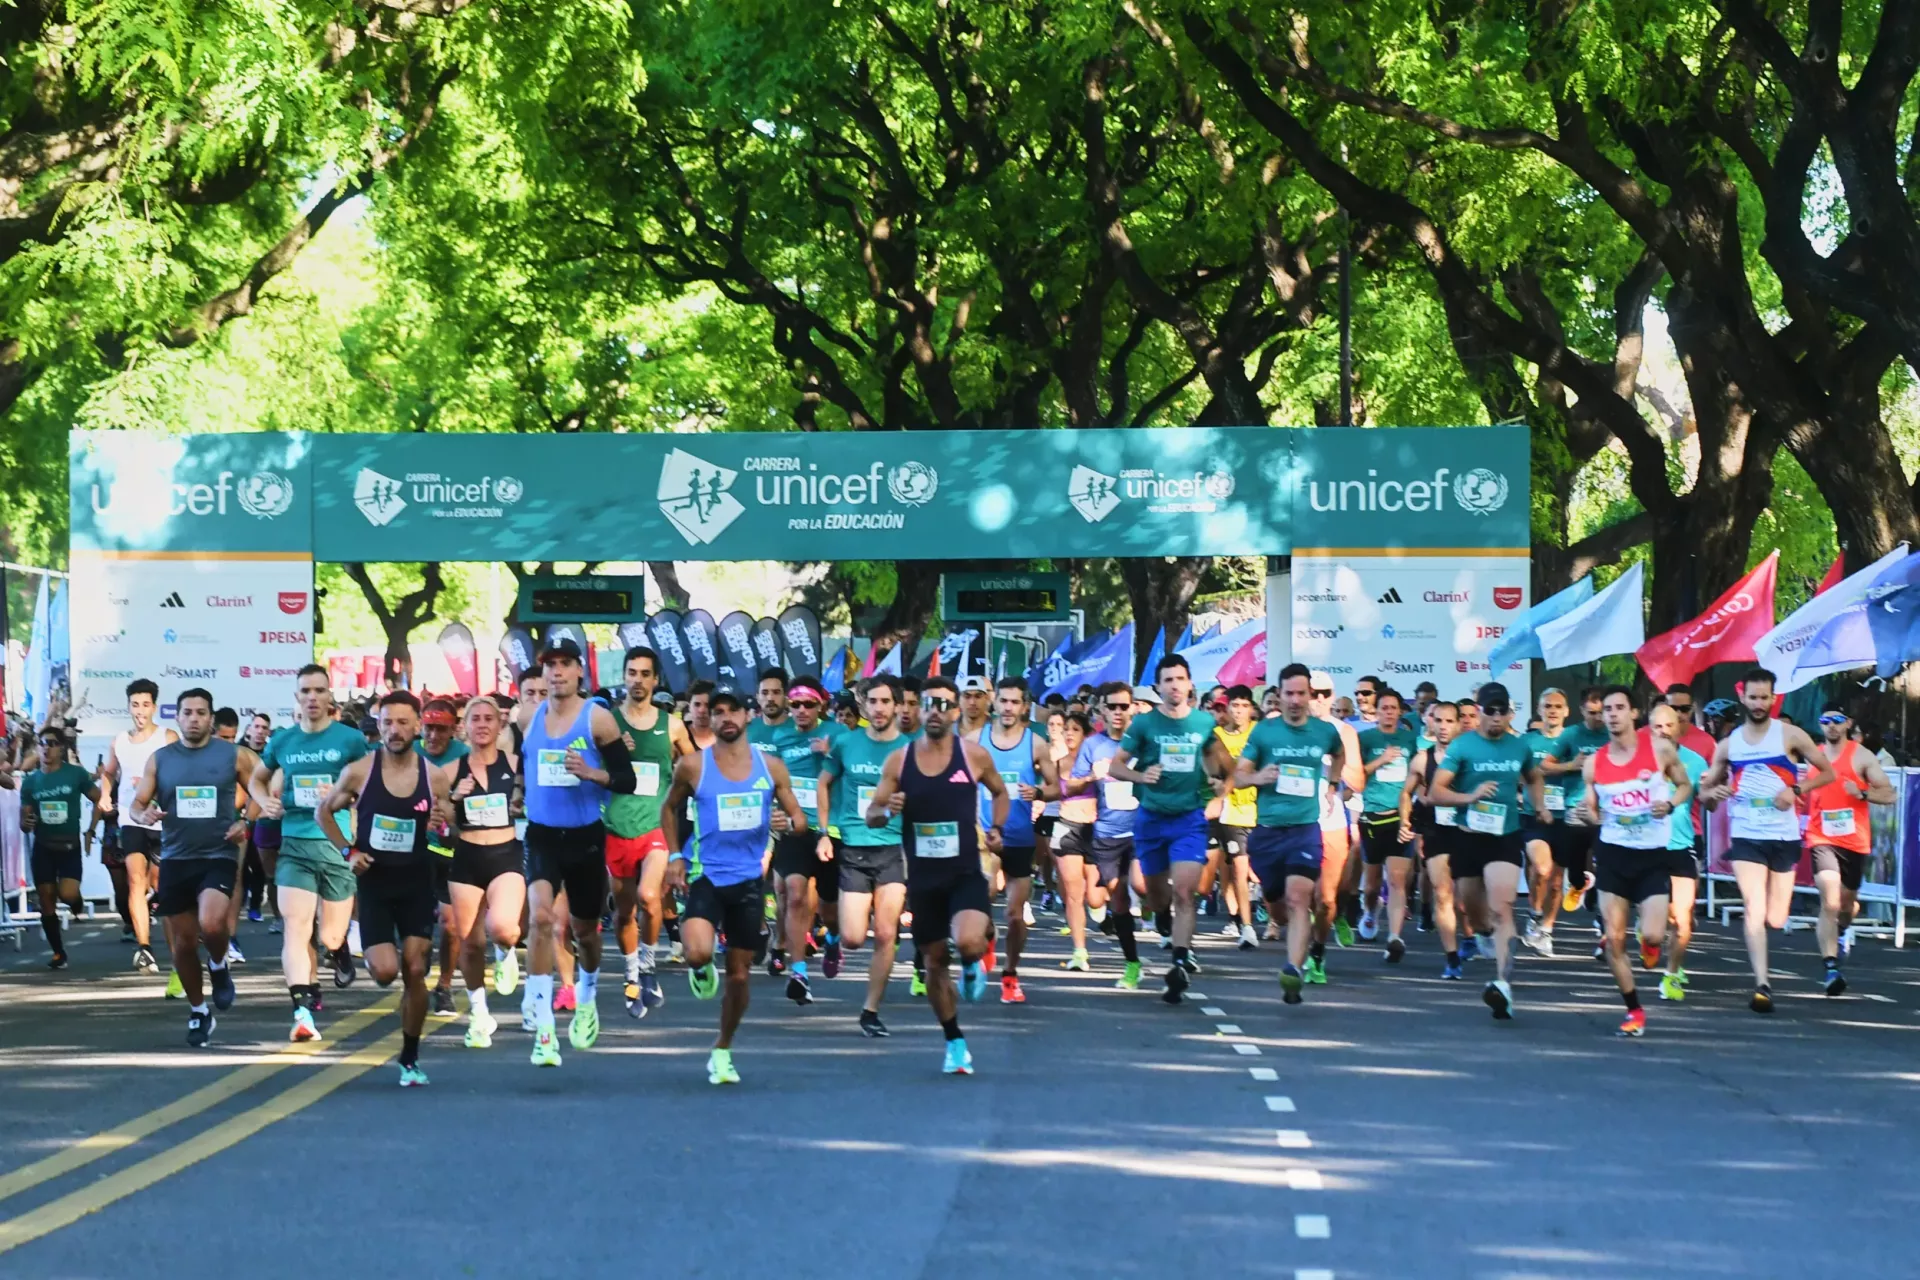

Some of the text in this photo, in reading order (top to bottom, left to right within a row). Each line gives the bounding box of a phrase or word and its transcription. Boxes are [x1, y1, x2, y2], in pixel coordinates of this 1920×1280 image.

[743, 457, 801, 471] CARRERA
[413, 476, 491, 503] unicef
[756, 461, 884, 505] unicef
[1126, 472, 1203, 499] unicef
[1310, 468, 1450, 512] unicef
[91, 471, 233, 516] ucef
[788, 510, 904, 530] POR LA EDUCACIÓN
[980, 577, 1016, 590] unicef
[269, 631, 307, 643] PEISA
[285, 749, 324, 764] unicef
[1272, 745, 1309, 757] unicef
[1473, 760, 1511, 772] unicef
